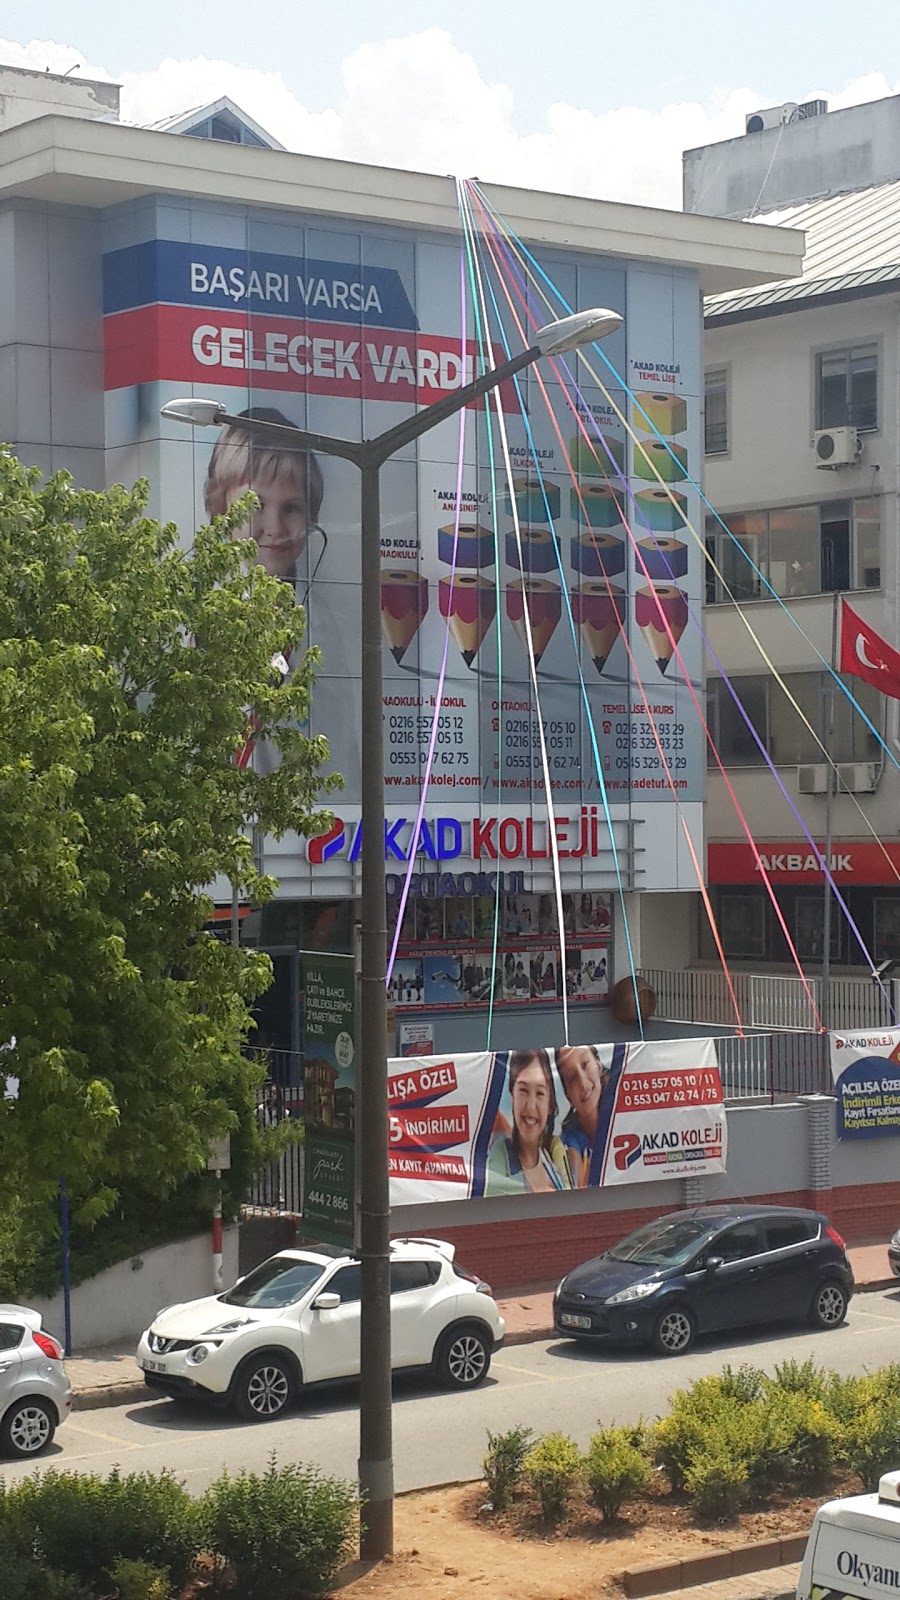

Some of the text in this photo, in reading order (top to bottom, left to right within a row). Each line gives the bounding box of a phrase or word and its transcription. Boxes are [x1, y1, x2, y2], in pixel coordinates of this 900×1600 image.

[190, 263, 383, 314] BAŞARI VARSA
[191, 324, 361, 381] GELECEK
[633, 361, 654, 371] AKAD
[639, 371, 660, 381] TEMEL
[379, 549, 417, 559] NAOKULU
[382, 695, 424, 707] NAOKULU
[602, 704, 627, 714] TEMEL
[653, 705, 674, 715] KURS
[389, 715, 414, 729] 0216
[437, 716, 451, 729] 05
[453, 716, 463, 729] 12
[505, 720, 529, 733] 0216
[550, 721, 563, 734] 05
[565, 722, 576, 734] 10
[658, 723, 670, 735] 93
[672, 723, 685, 735] 29
[389, 731, 414, 744] 0216
[437, 731, 451, 744] 05
[453, 731, 464, 744] 13
[505, 735, 529, 748] 0216
[550, 736, 563, 749] 05
[565, 736, 573, 748] 11
[672, 738, 684, 750] 23
[389, 751, 469, 765] 0553 07 62 75
[505, 755, 531, 768] 0553
[553, 756, 566, 768] 62
[642, 757, 660, 769] 329
[675, 757, 687, 769] 29
[383, 773, 482, 788] ww.akakolej.com
[491, 776, 586, 790] www.akadse.com
[471, 805, 598, 860] KOLEJİ
[844, 1039, 867, 1049] AKAD
[387, 1068, 456, 1100] LIŞA ÖZEL
[623, 1080, 630, 1091] 0
[631, 1079, 649, 1091] 216
[651, 1077, 668, 1089] 557
[670, 1076, 683, 1087] 05
[685, 1075, 696, 1086] 10
[704, 1074, 714, 1084] 11
[842, 1081, 881, 1096] AÇILIŞA
[625, 1095, 632, 1106] 0
[633, 1094, 652, 1106] 553
[653, 1092, 671, 1103] 047
[673, 1090, 686, 1101] 62
[686, 1089, 699, 1100] 74
[706, 1088, 718, 1099] 75
[404, 1115, 466, 1136] İNDİRİMLİ
[642, 1123, 722, 1150] AKAD KOLEJİ
[399, 1158, 422, 1173] KAYIT
[308, 1190, 325, 1206] 444
[326, 1194, 332, 1207] 2
